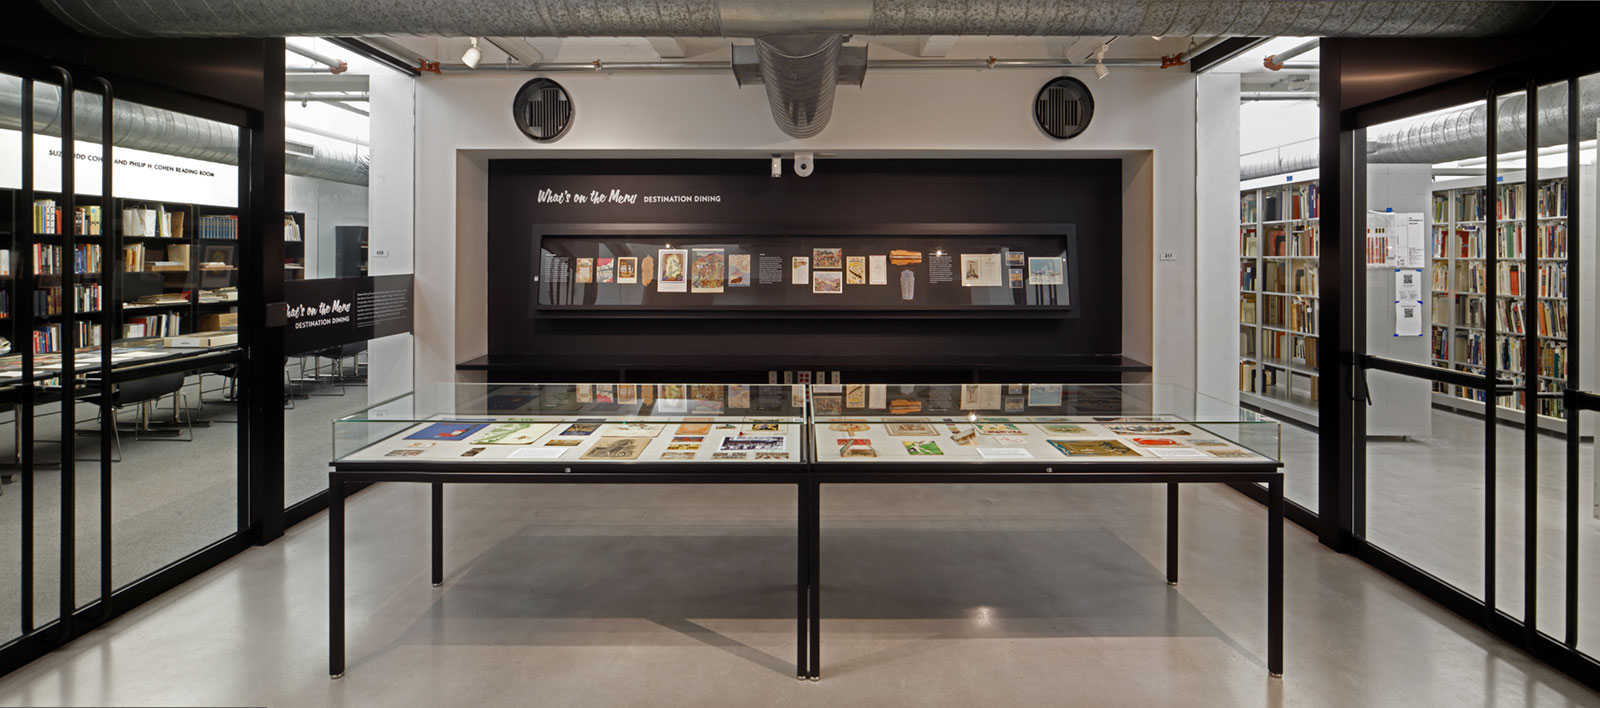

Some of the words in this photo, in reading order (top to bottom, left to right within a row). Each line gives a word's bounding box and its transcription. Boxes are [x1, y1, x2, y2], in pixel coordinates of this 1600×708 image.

[49, 149, 63, 157] SUZ
[129, 160, 146, 168] PHILIP
[175, 166, 198, 175] READING
[537, 188, 572, 204] What's
[573, 193, 588, 203] on
[590, 190, 607, 205] the
[608, 189, 638, 204] Menu
[643, 195, 693, 203] DESTINATION
[694, 195, 721, 203] DINING
[286, 303, 305, 319] hat's
[306, 306, 318, 316] on
[319, 301, 331, 316] the
[332, 299, 352, 314] Menu
[295, 318, 331, 329] DESTINATION
[332, 315, 350, 324] DINING
